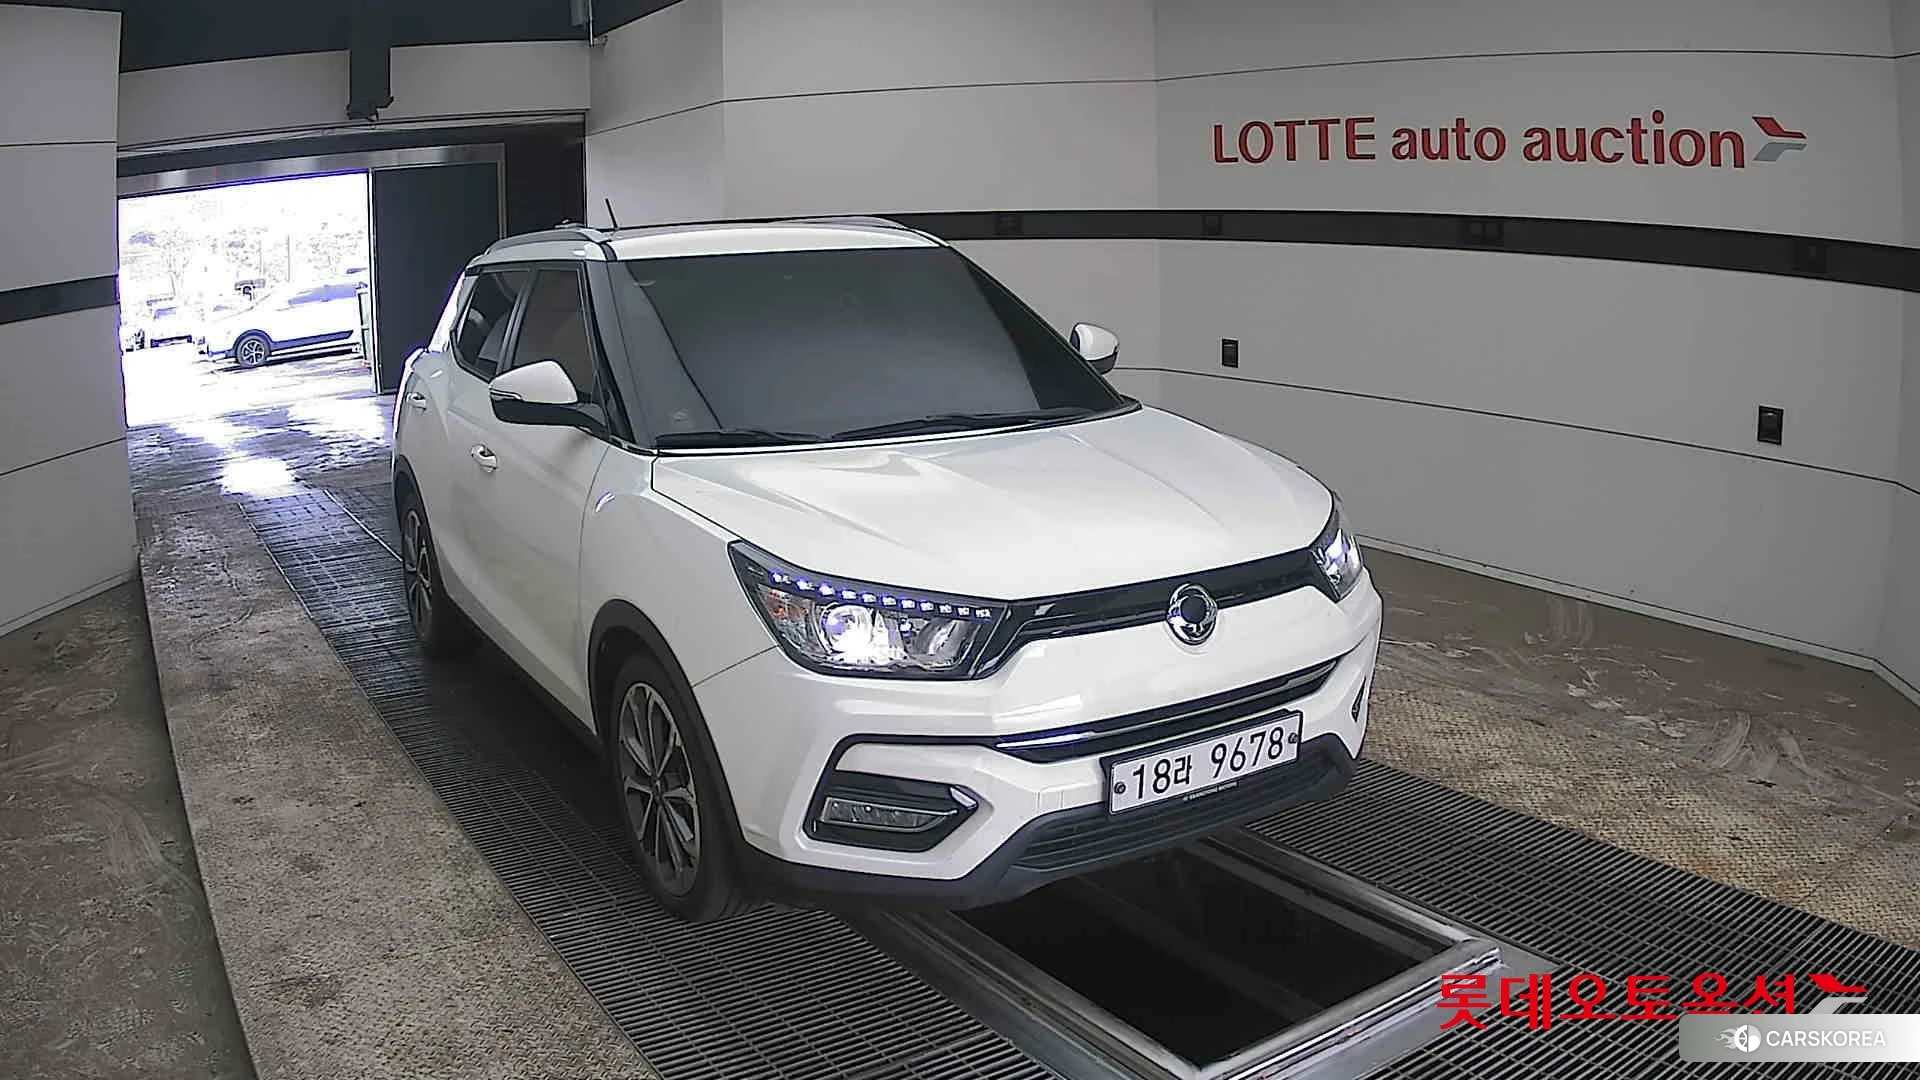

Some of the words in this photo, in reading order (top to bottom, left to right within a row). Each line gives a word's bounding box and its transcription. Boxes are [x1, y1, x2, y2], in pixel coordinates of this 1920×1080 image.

[1211, 116, 1376, 163] LOTTE
[1391, 117, 1507, 161] auto
[1522, 109, 1746, 168] auction
[1132, 754, 1193, 800] 18라
[1211, 726, 1285, 779] 9678
